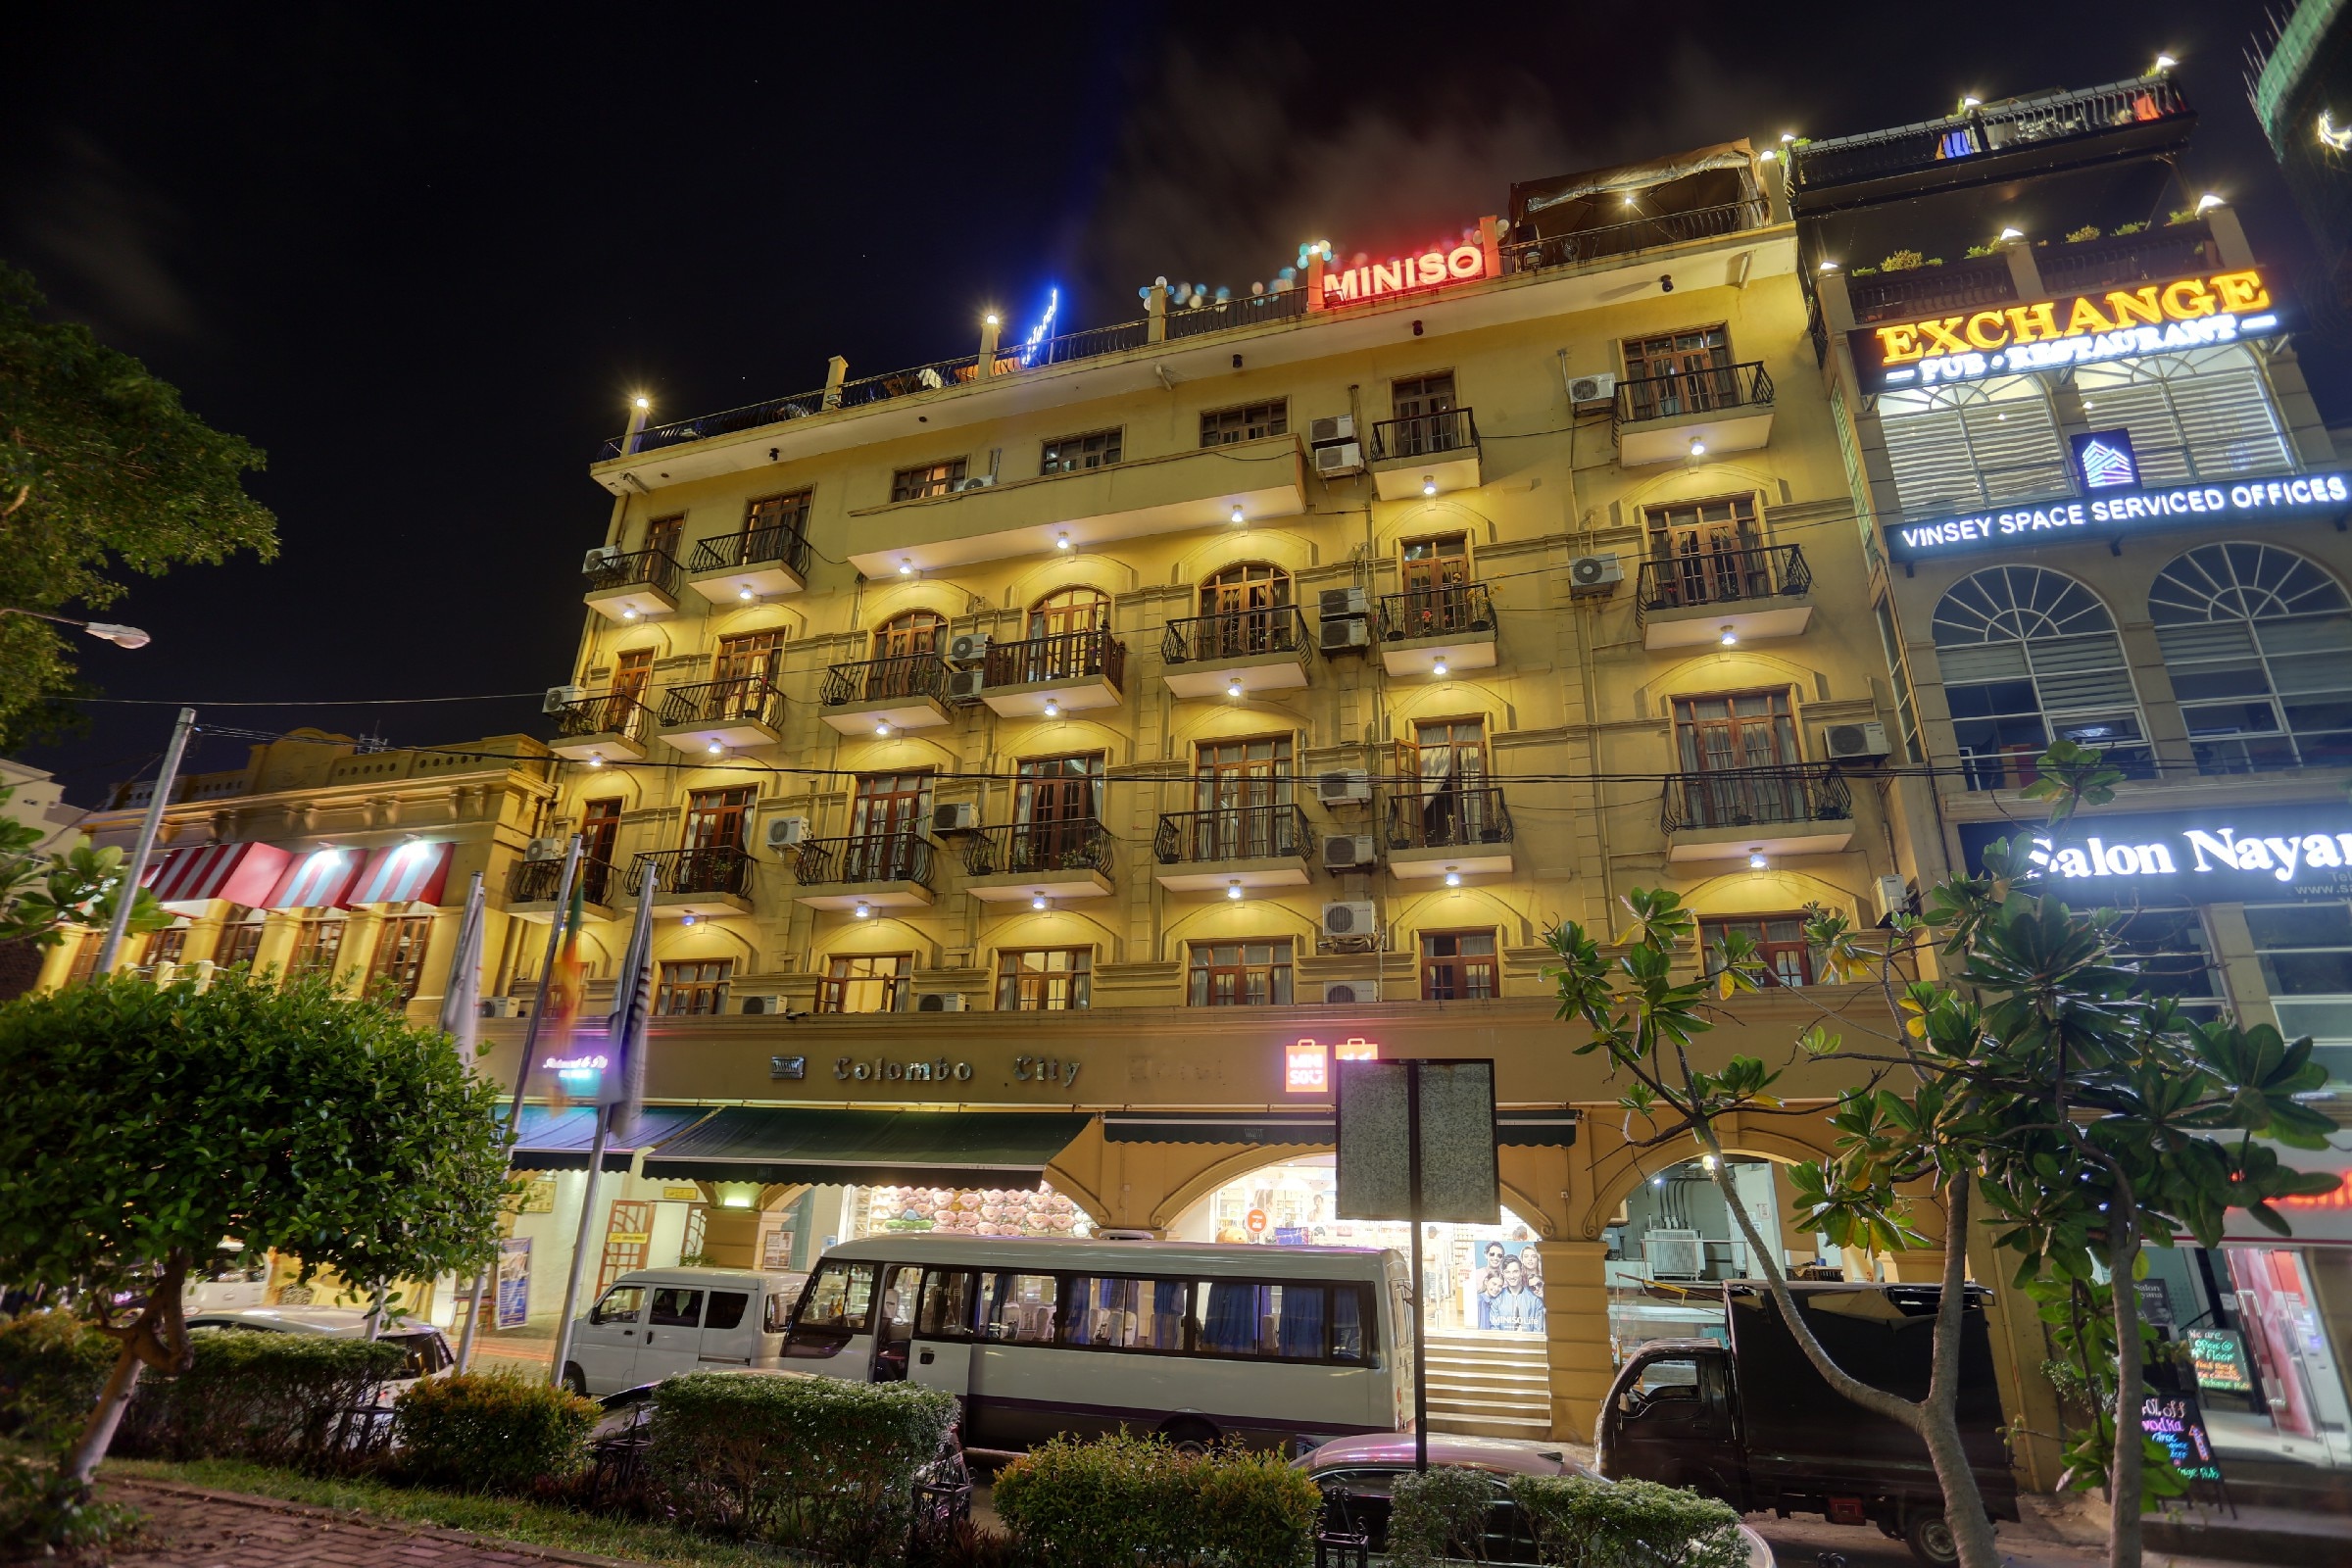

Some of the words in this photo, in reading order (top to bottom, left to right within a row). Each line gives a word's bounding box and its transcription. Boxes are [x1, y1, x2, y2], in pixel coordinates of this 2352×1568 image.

[1324, 246, 1483, 301] MINISO
[1876, 270, 2271, 365] EXCHANGE
[1919, 353, 1986, 383] PUB
[2005, 315, 2238, 370] RESTAURANT
[1902, 515, 1990, 549] VINSEY
[1999, 504, 2084, 534] SPACE
[2091, 488, 2224, 521] SERVICED
[2231, 476, 2348, 509] OFFICES
[2027, 837, 2177, 878] Salon
[833, 1056, 972, 1081] Colombo
[1013, 1055, 1080, 1087] City
[1290, 1054, 1323, 1068] MINI
